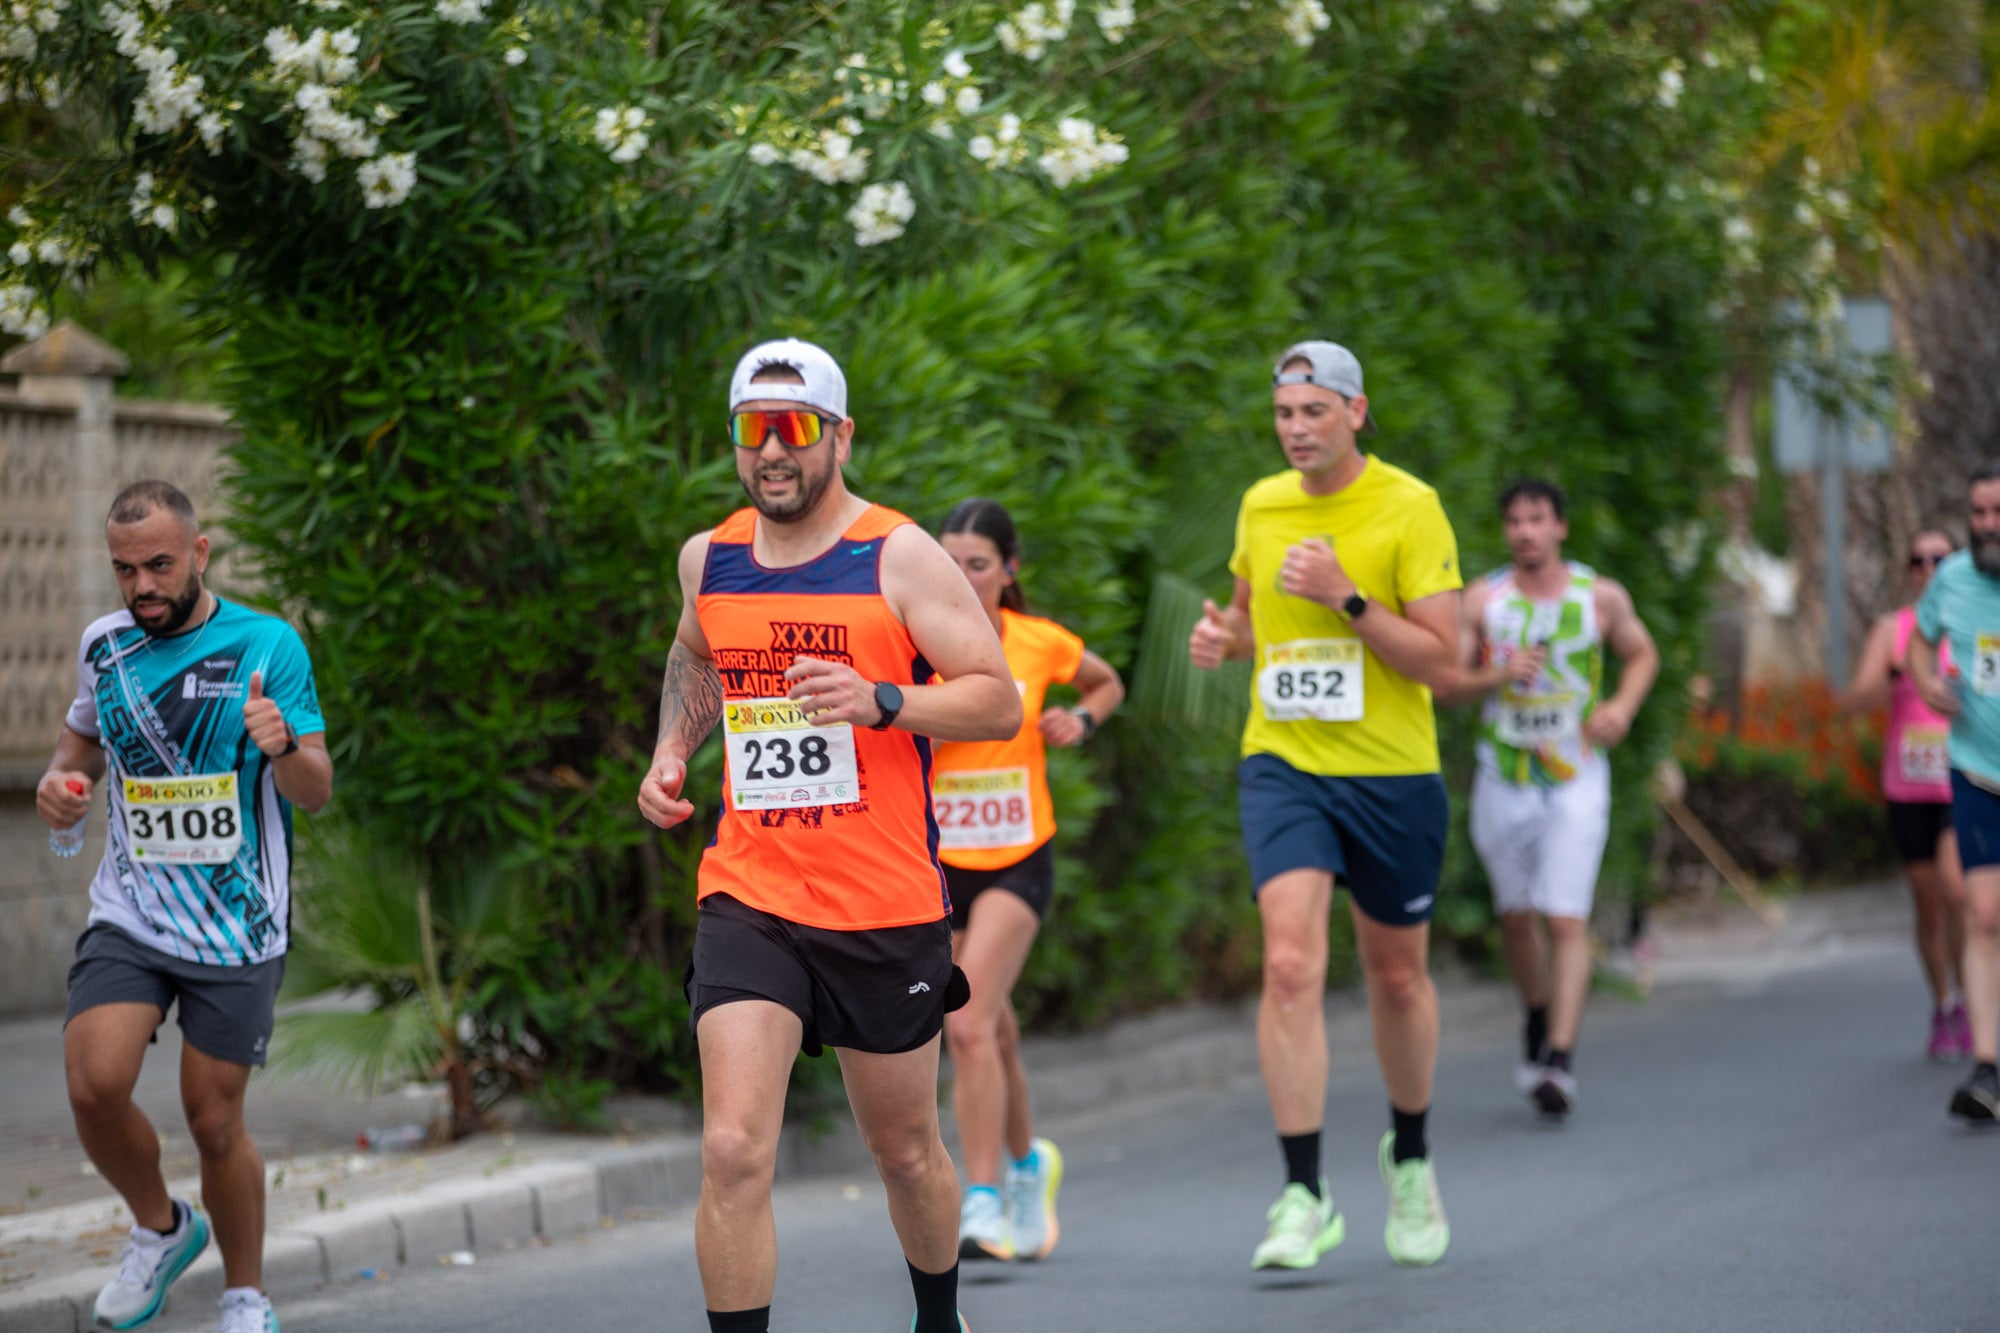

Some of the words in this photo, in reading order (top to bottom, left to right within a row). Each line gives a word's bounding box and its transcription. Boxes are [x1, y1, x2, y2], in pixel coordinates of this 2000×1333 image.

[771, 623, 847, 653] XXXII
[713, 650, 771, 670] ARRERA
[774, 652, 793, 671] DE
[720, 672, 757, 695] ILLA
[760, 674, 786, 696] DE
[1277, 671, 1345, 699] 852
[131, 676, 168, 739] CARRERA
[740, 707, 753, 725] 38
[744, 736, 831, 780] 238
[136, 784, 153, 799] 38
[130, 807, 236, 840] 3108
[935, 798, 1025, 827] 2208
